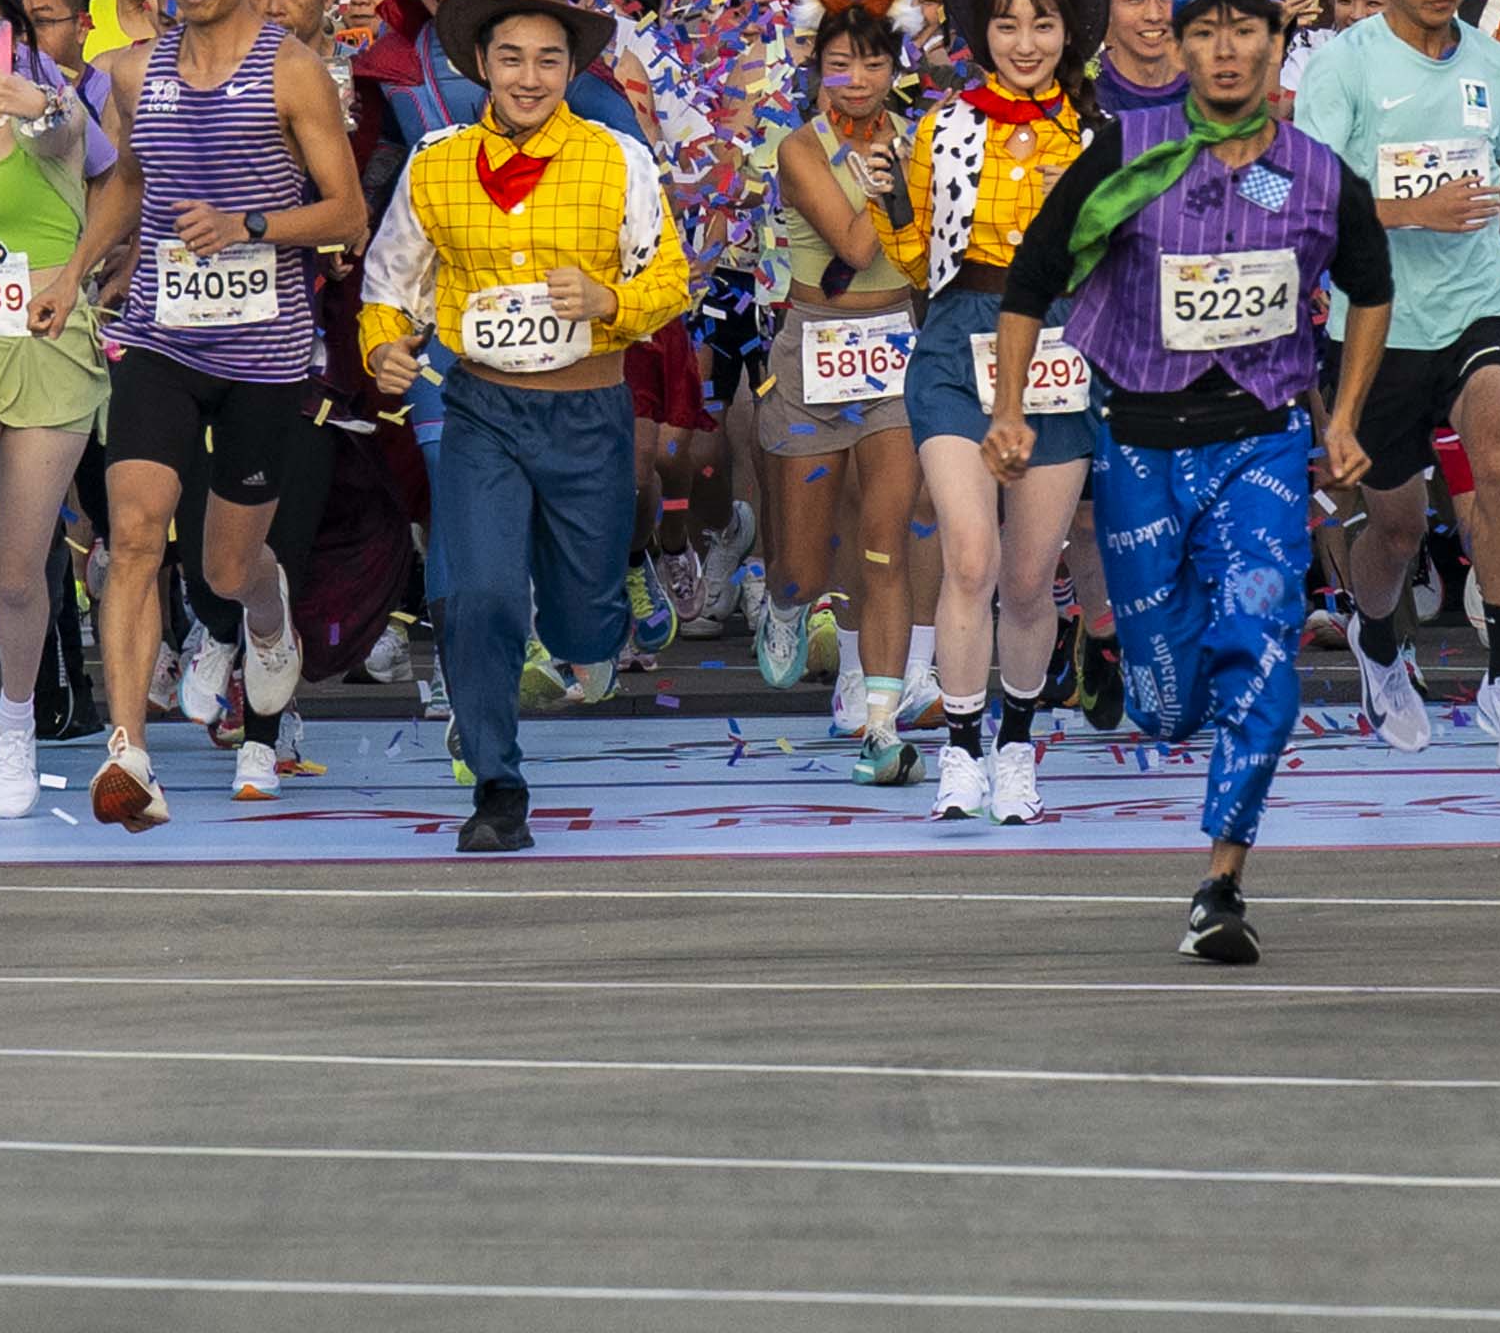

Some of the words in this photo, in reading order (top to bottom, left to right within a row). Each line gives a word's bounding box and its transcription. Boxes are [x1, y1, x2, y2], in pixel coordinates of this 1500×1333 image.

[165, 269, 268, 301] 54059
[1174, 282, 1289, 321] 52234
[475, 315, 577, 350] 52207
[816, 346, 906, 378] 58163
[987, 355, 1088, 389] 5292
